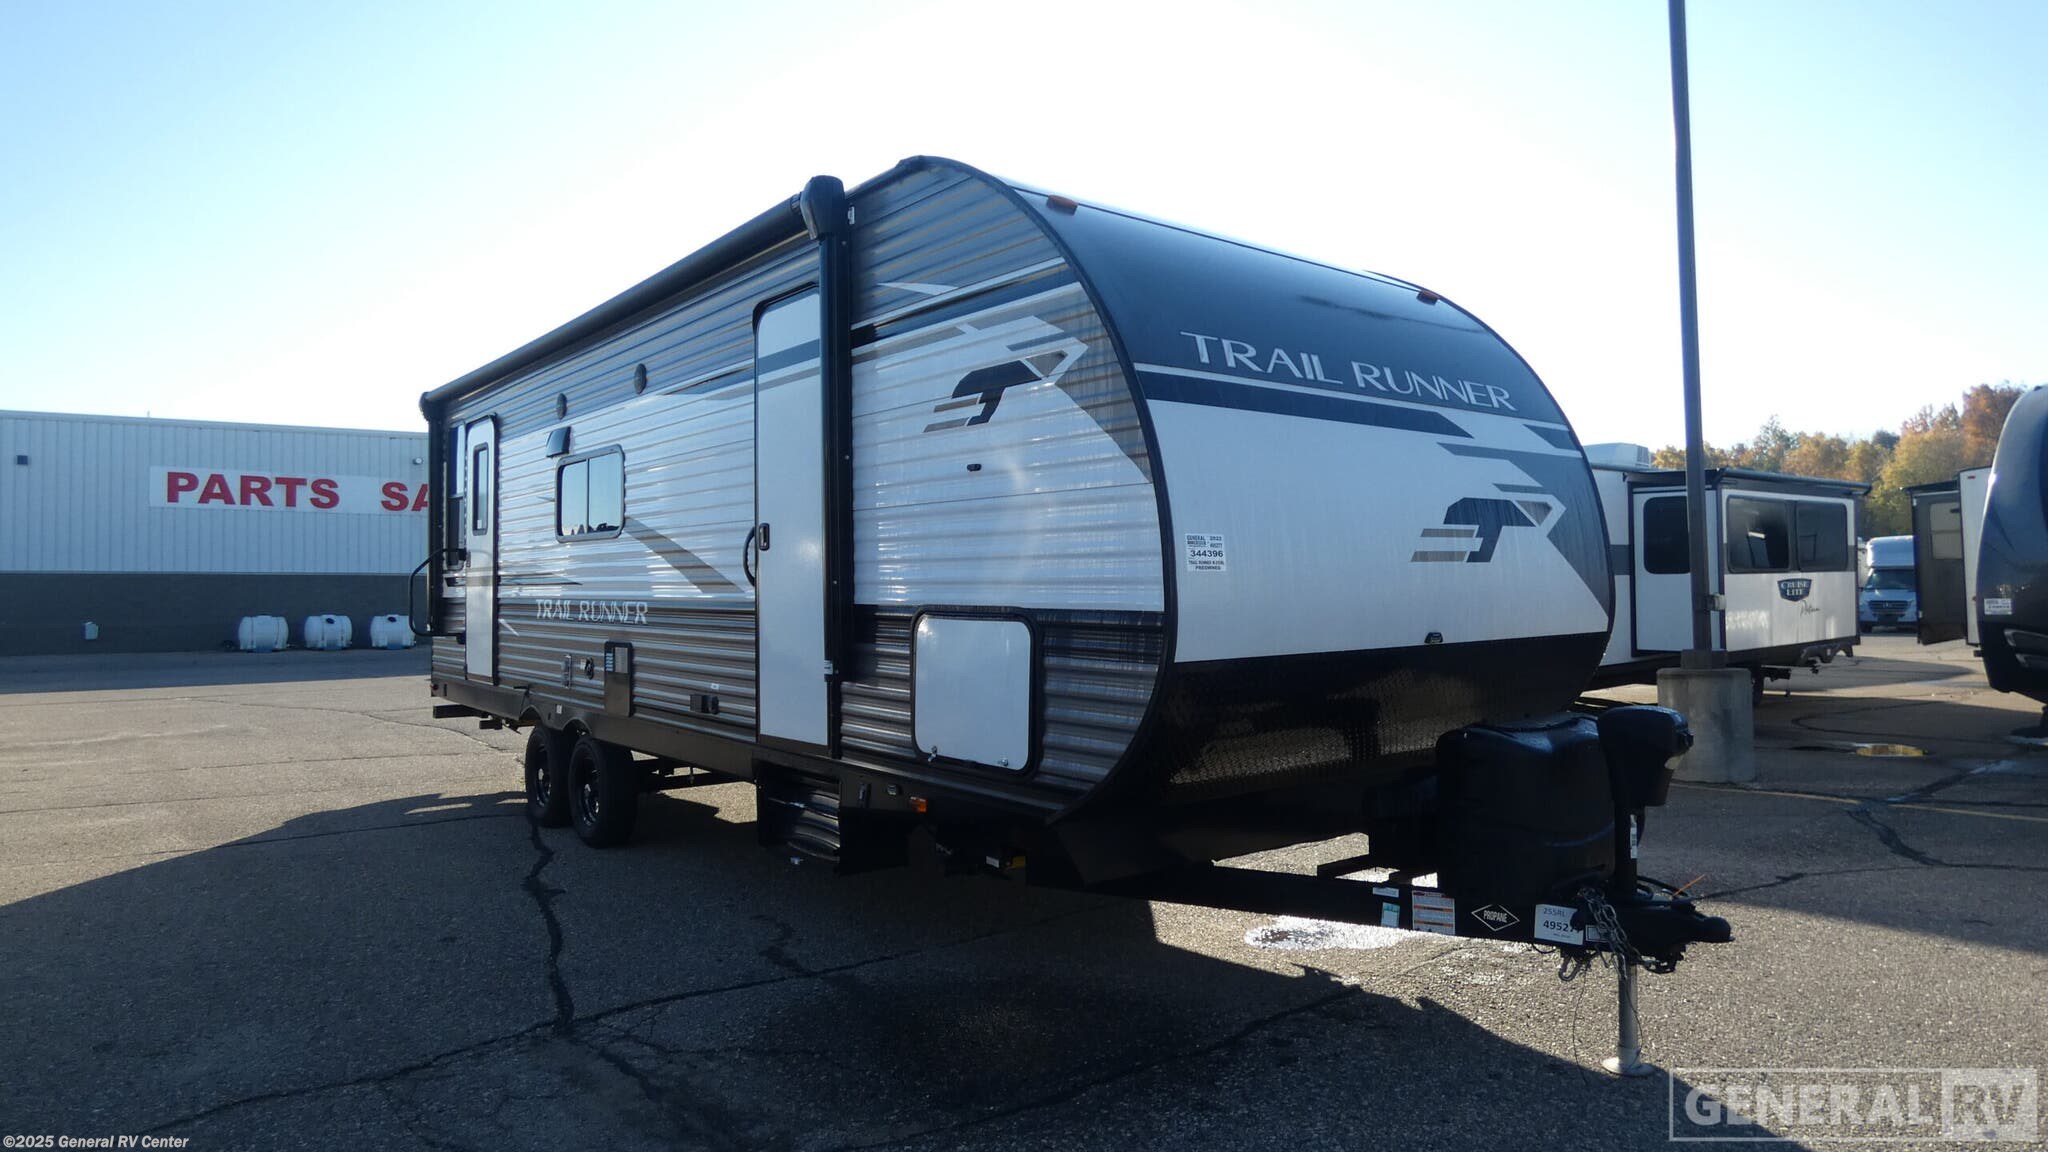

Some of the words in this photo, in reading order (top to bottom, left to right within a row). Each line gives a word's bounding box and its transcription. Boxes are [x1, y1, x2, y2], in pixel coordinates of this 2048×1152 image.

[1180, 331, 1343, 385] TRAIL
[1351, 361, 1519, 411] RUNNER
[167, 471, 340, 509] PARTS
[1781, 580, 1810, 589] CRUISE
[536, 599, 574, 620] TRAIL
[579, 600, 648, 624] RUNNER
[1483, 910, 1507, 923] PROPANE
[1543, 920, 1580, 933] 4952
